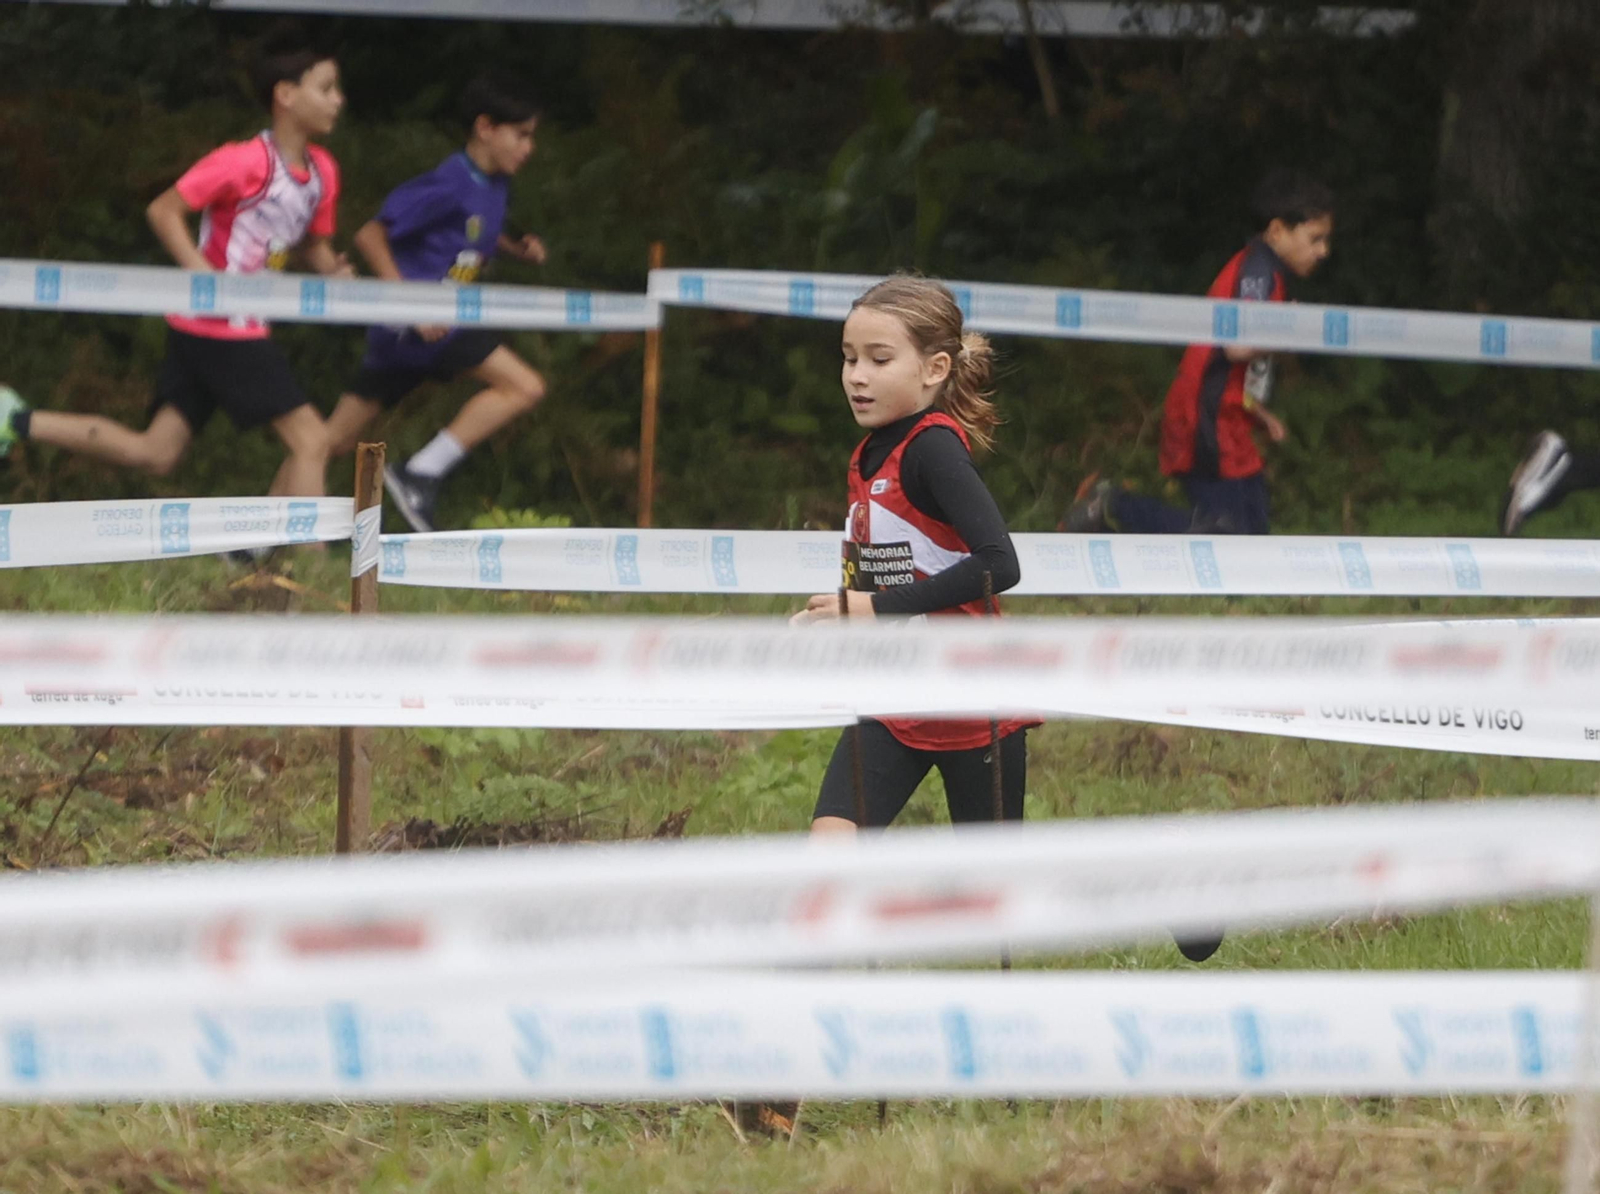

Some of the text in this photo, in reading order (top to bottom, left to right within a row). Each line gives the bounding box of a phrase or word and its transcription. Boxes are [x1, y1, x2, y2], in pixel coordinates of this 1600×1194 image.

[860, 546, 912, 559] MEMORIAL
[858, 559, 914, 573] BELARMINO
[873, 573, 914, 586] ALONSO
[1320, 704, 1430, 726] CONCELLO
[1438, 706, 1465, 728] DE
[1473, 708, 1523, 731] VIGO
